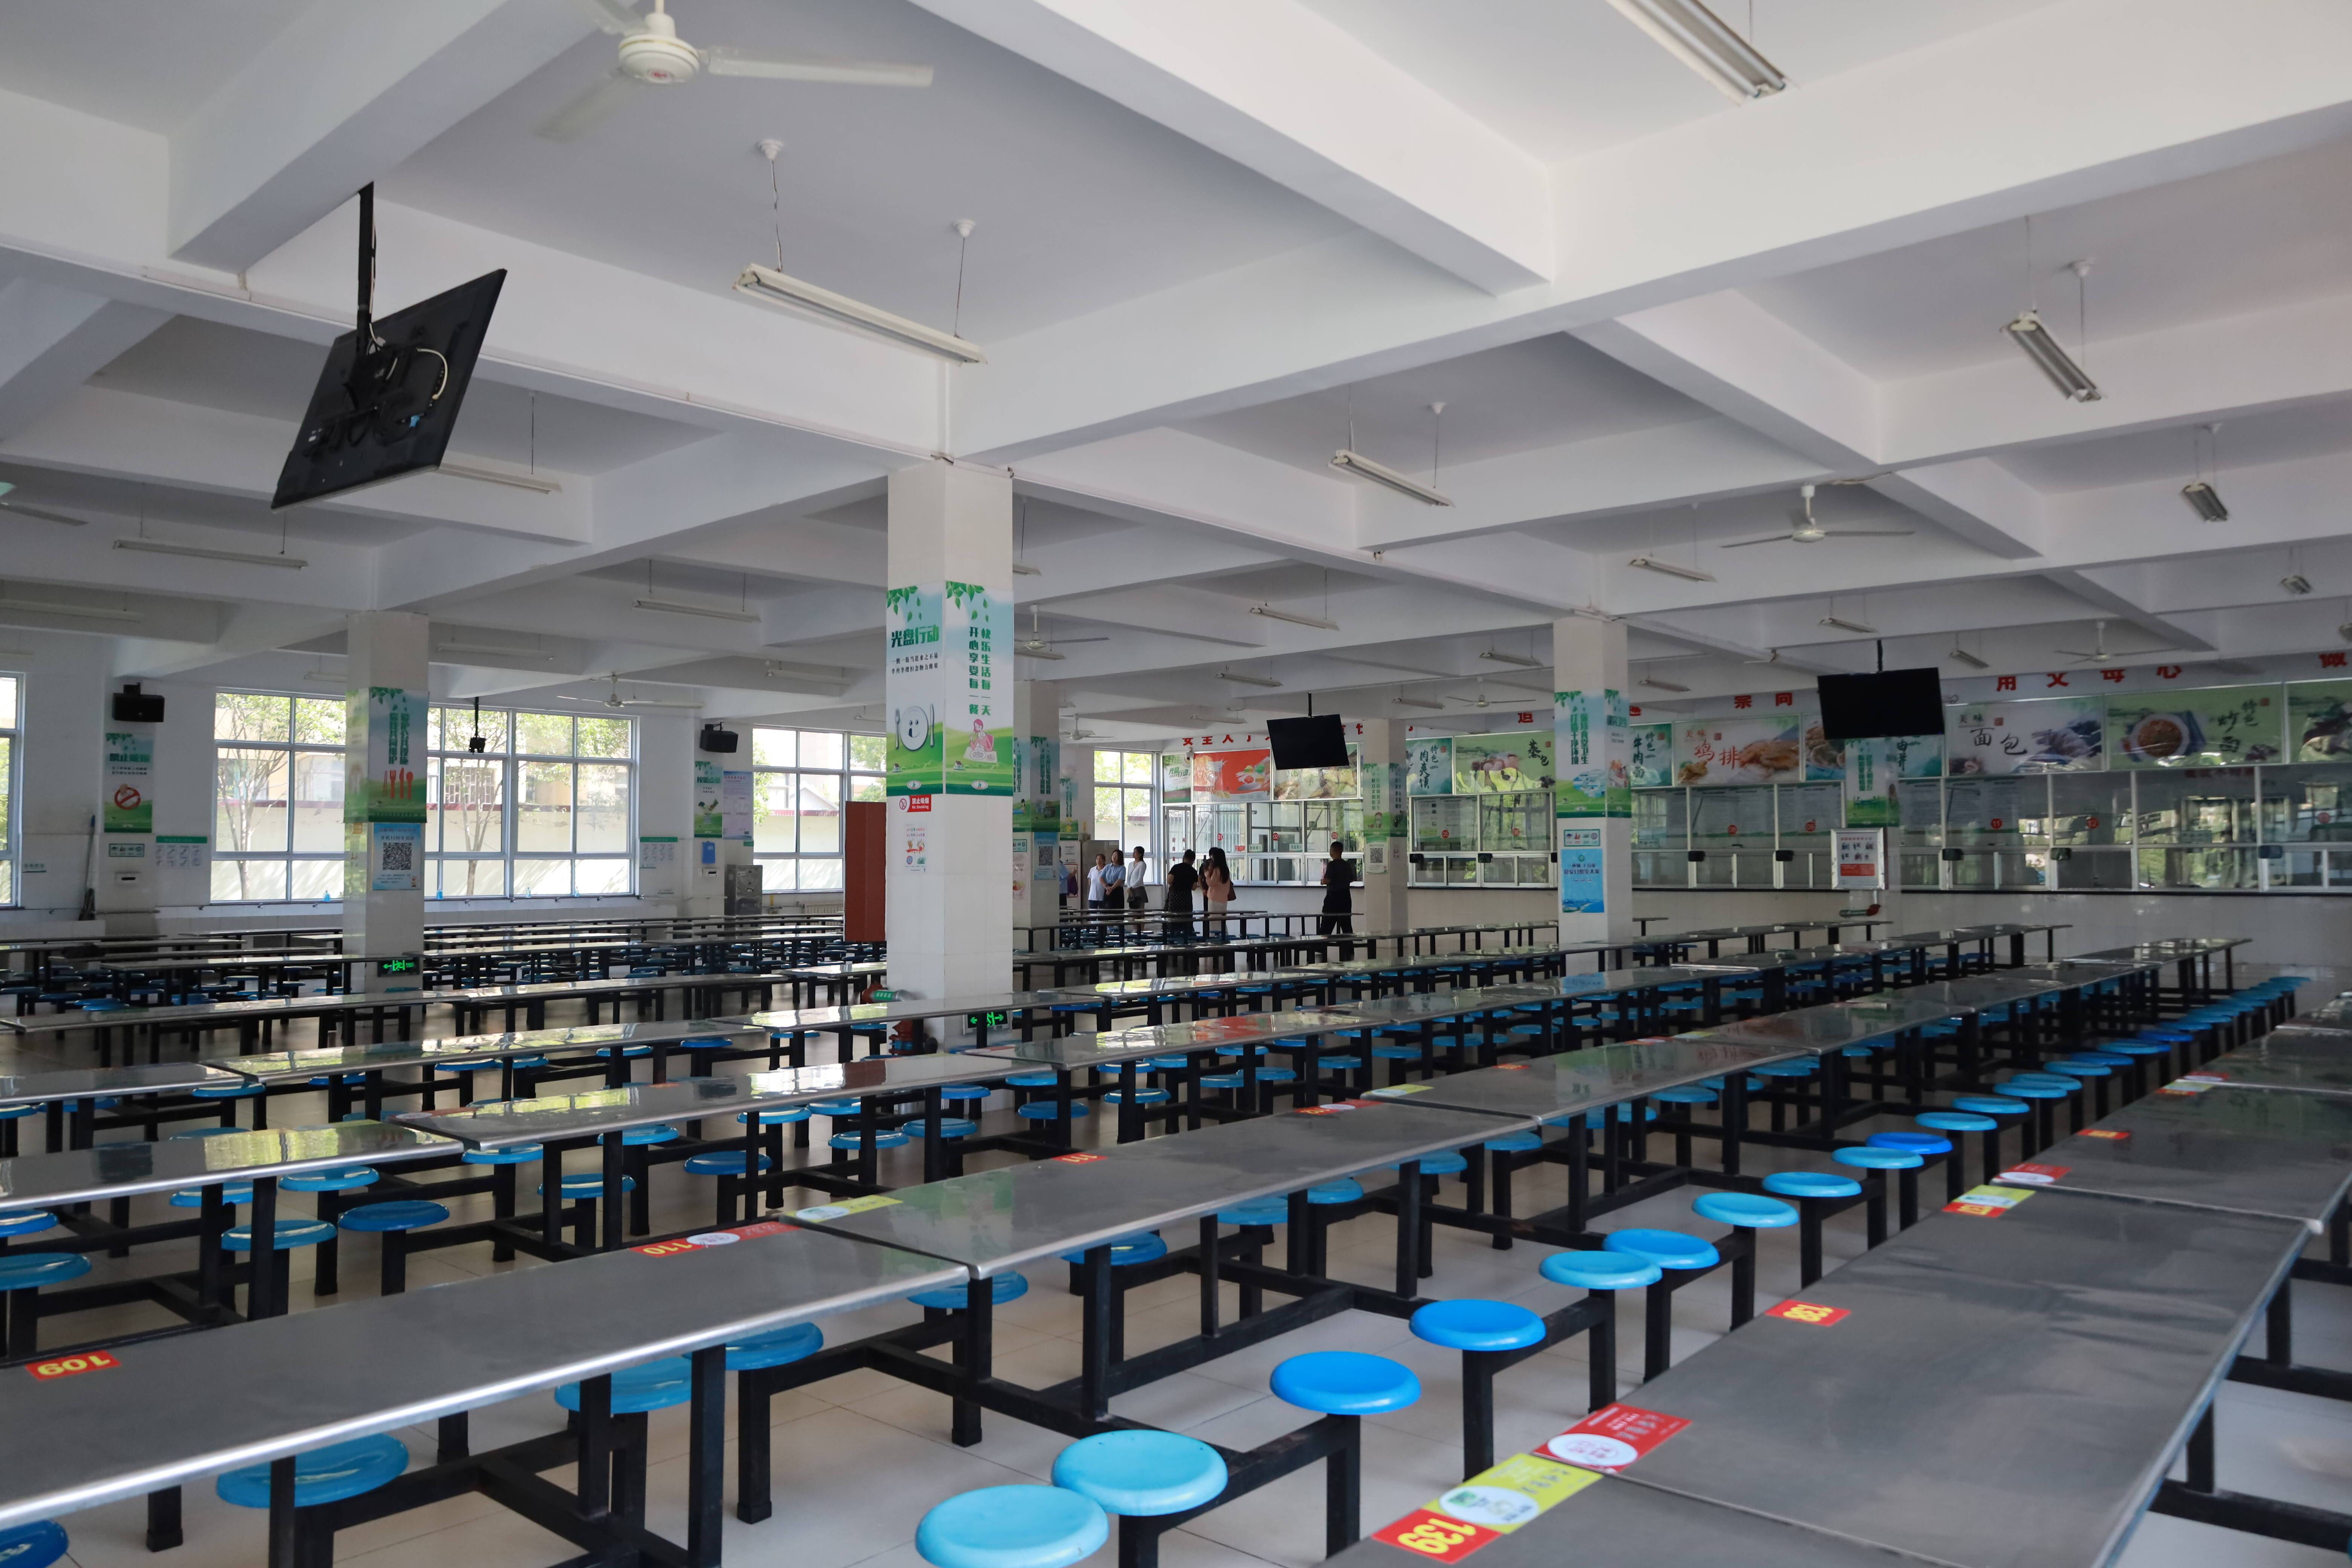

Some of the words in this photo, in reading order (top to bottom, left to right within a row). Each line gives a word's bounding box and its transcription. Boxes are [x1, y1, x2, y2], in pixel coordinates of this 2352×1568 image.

[891, 625, 939, 648] 光盘行动
[891, 653, 938, 664] 一粥一饭当思来之不易
[969, 626, 979, 715] 开心享受每一餐
[981, 628, 991, 716] 快乐生活每一天
[1970, 727, 2027, 755] 面包
[643, 1243, 692, 1255] 110
[1783, 1304, 1834, 1323] 138
[38, 1355, 110, 1375] 109
[1398, 1518, 1477, 1554] 139
